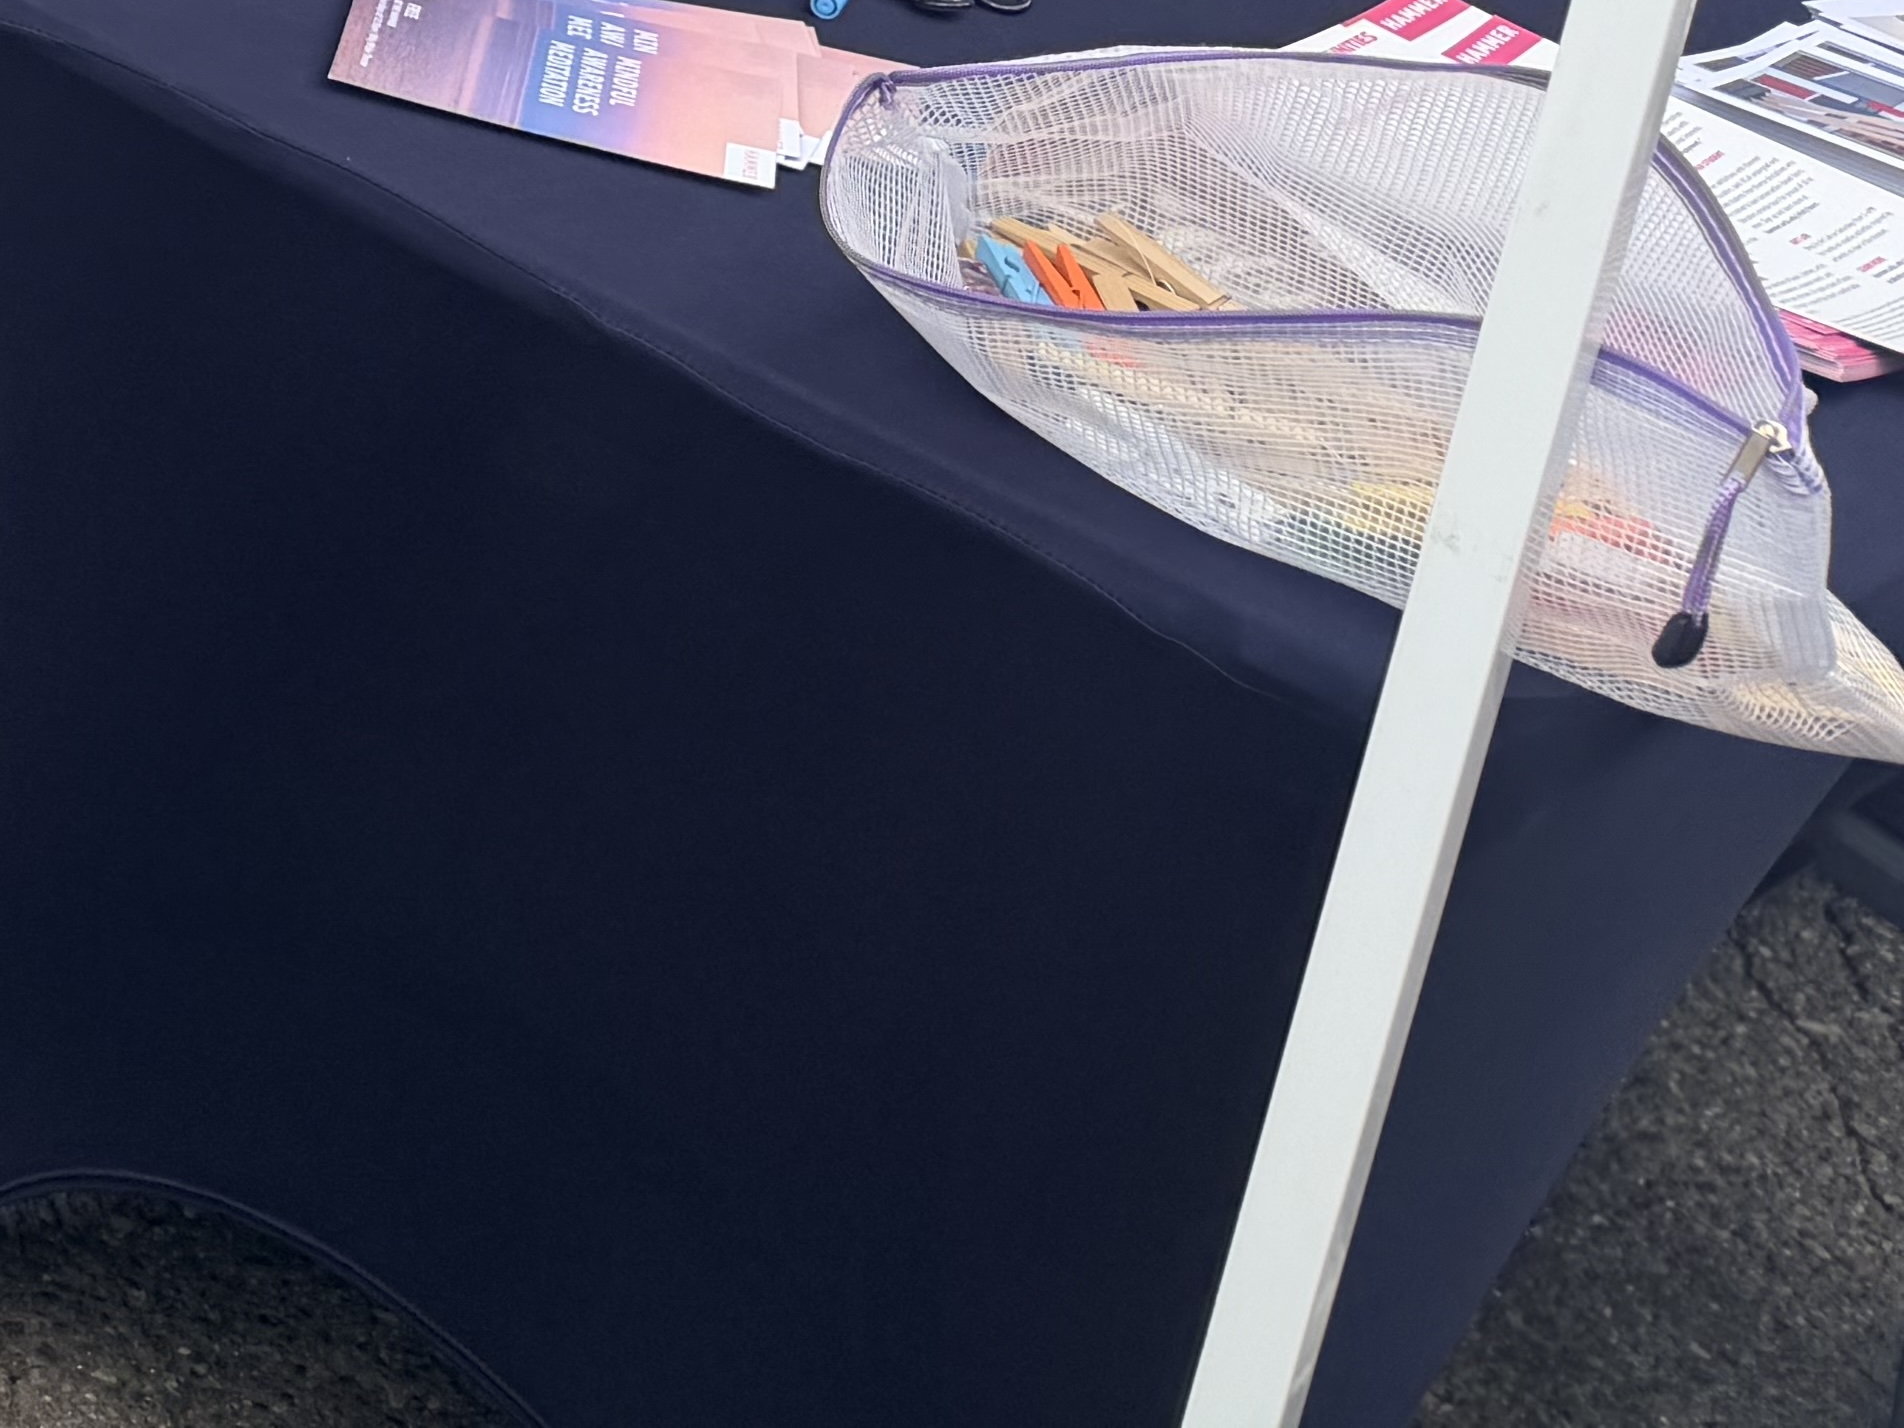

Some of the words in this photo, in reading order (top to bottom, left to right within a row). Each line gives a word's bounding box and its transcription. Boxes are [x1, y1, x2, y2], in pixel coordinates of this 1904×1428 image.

[539, 40, 576, 107] MEDITATION
[1456, 23, 1520, 65] HAMMER
[572, 47, 609, 117] AWARENESS
[609, 55, 642, 107] MINDFUL
